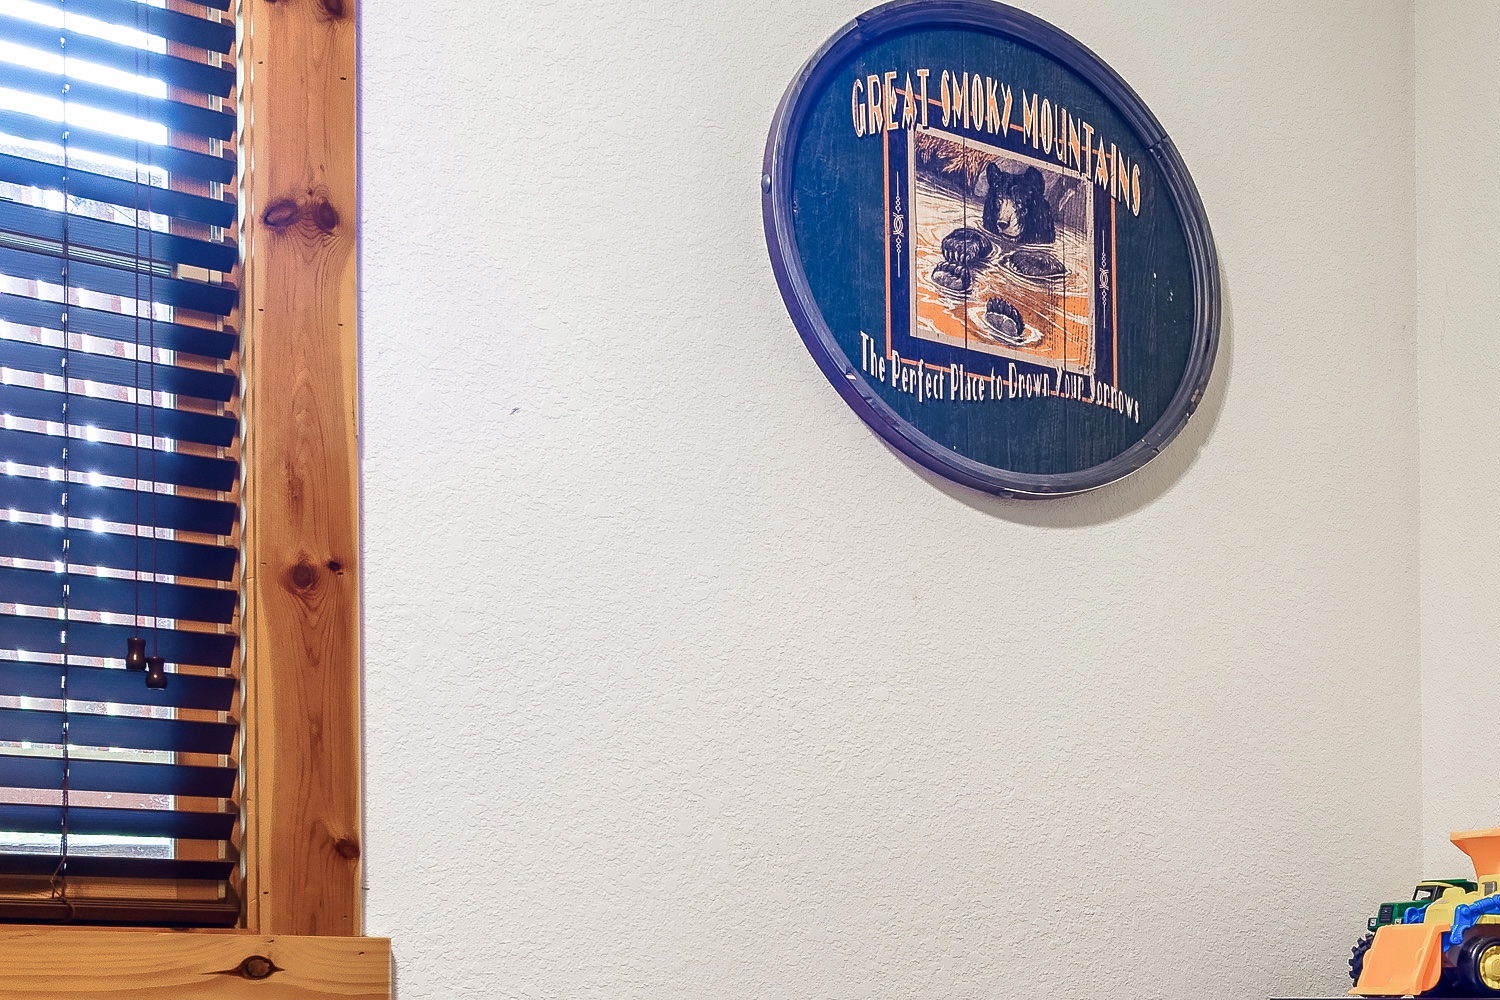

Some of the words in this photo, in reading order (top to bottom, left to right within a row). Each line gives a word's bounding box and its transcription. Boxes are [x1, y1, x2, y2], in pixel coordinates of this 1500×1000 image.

[851, 68, 930, 138] GREAT
[940, 69, 1013, 138] SMOKY
[1022, 88, 1141, 217] MOUNTAINS
[860, 331, 886, 383] The
[891, 349, 945, 403] Perfect
[950, 363, 985, 401] Place
[990, 367, 1003, 400] to
[1008, 362, 1050, 399] Drown
[1055, 366, 1084, 400] Your
[1089, 370, 1139, 424] Sorrows
